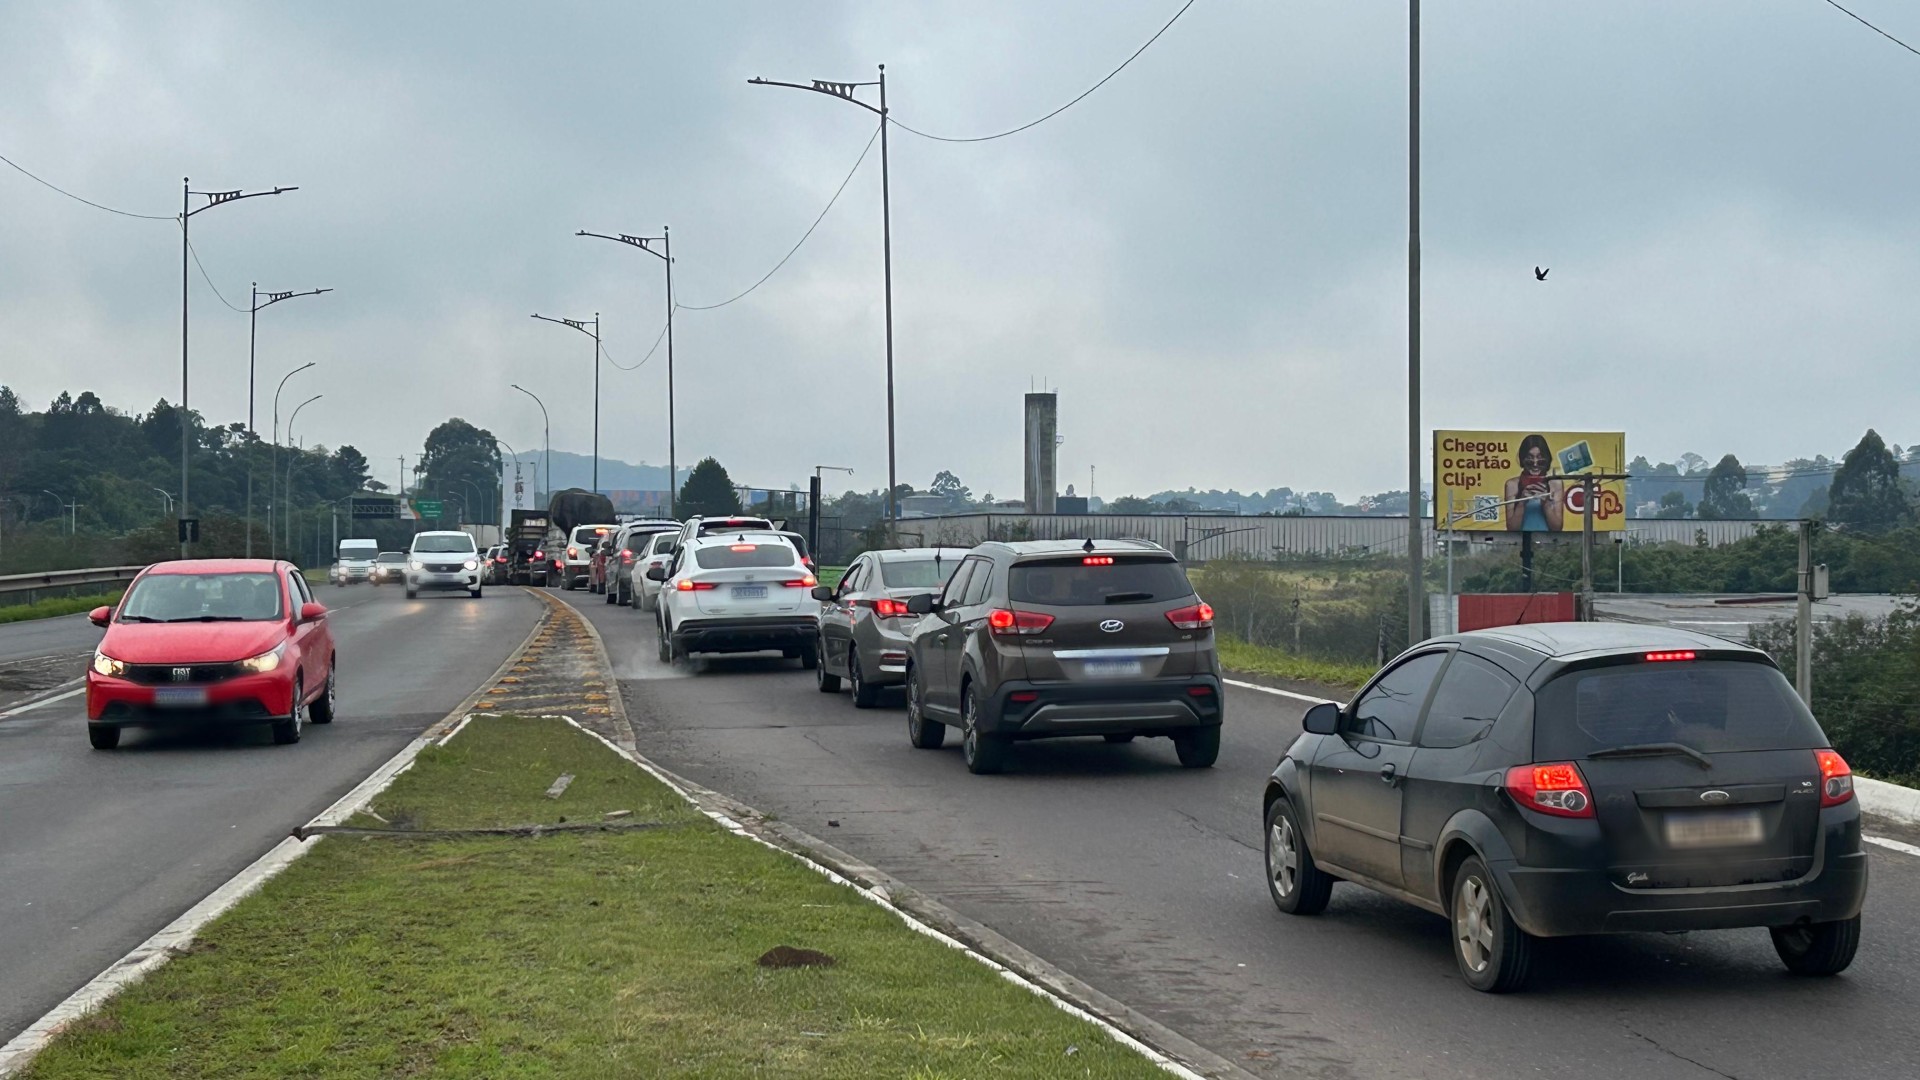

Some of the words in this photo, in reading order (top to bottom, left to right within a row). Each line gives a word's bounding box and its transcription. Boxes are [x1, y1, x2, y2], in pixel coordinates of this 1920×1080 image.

[1442, 438, 1508, 456] Chegou
[1442, 458, 1453, 469] o
[1456, 455, 1511, 469] cartão
[1442, 472, 1482, 490] Clip!
